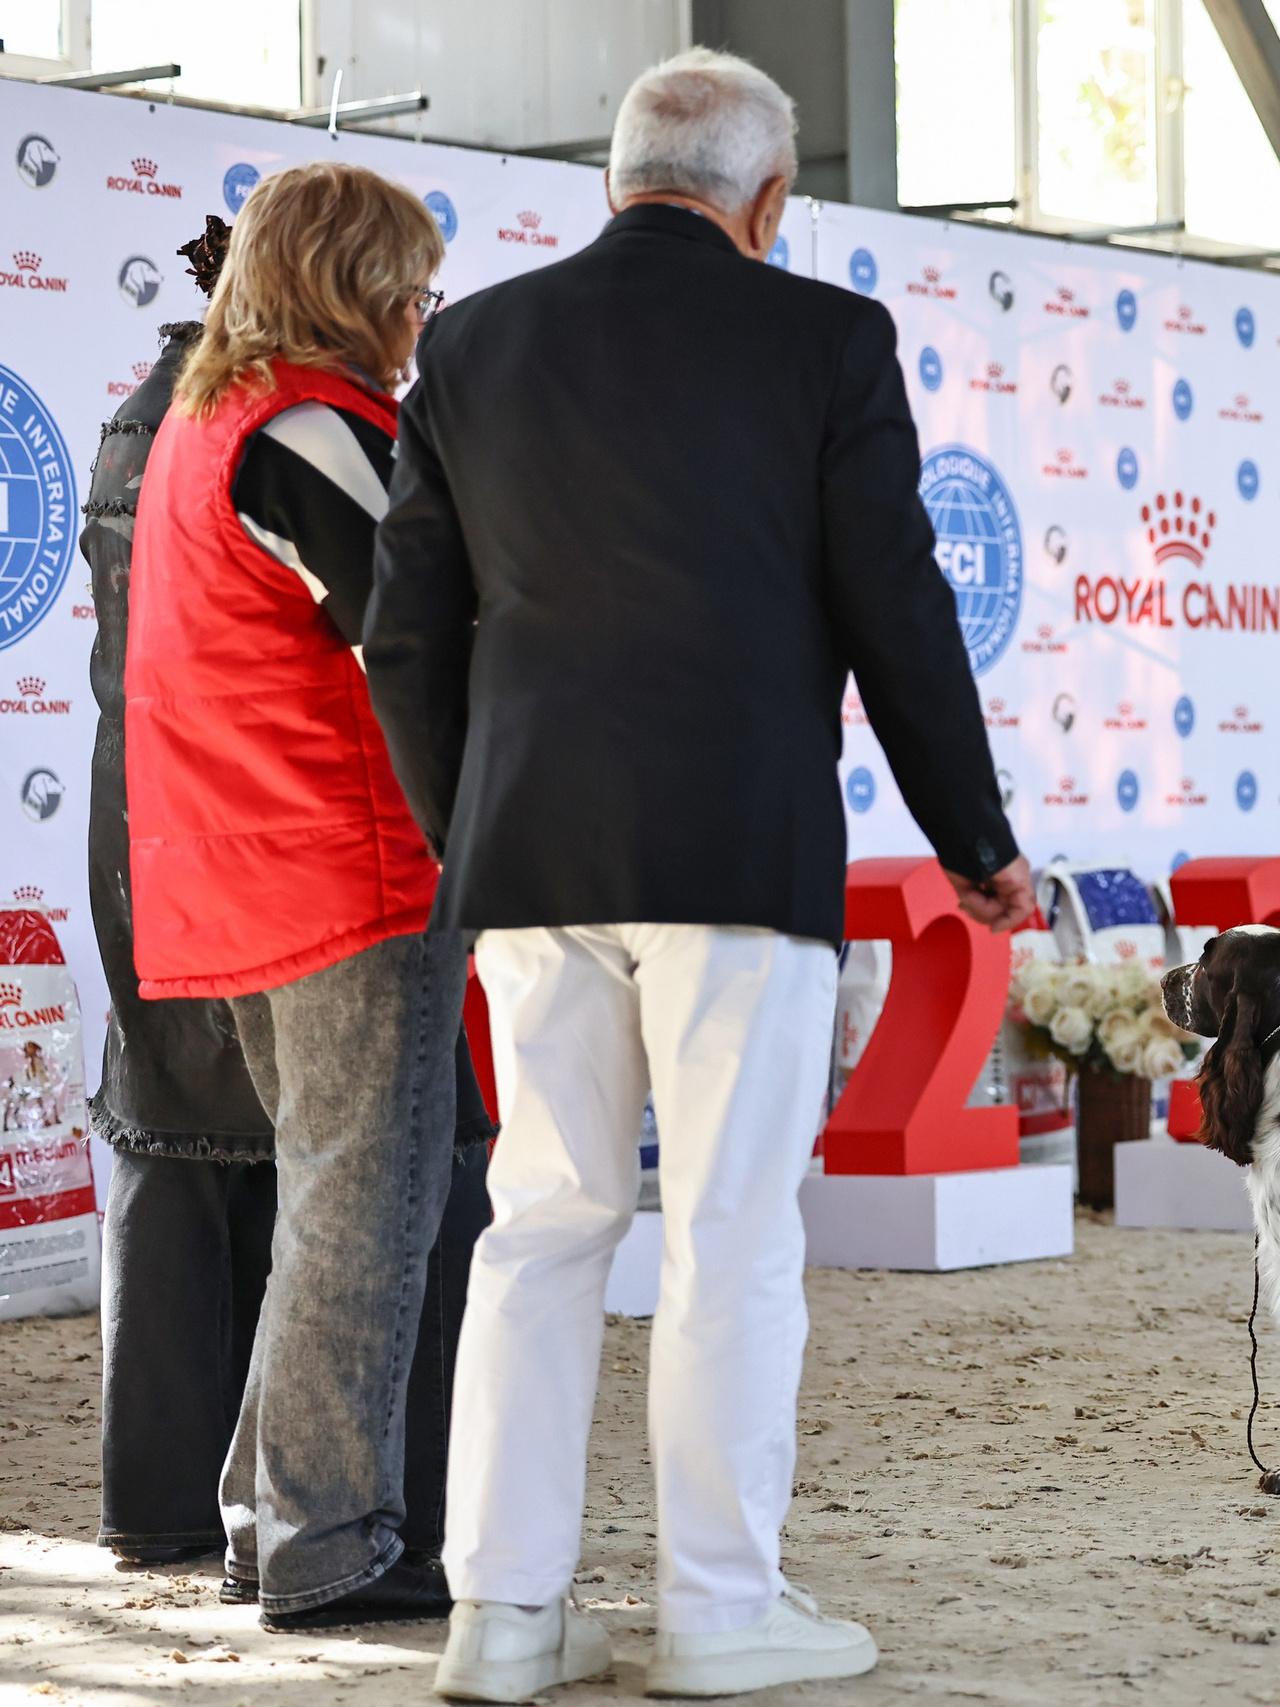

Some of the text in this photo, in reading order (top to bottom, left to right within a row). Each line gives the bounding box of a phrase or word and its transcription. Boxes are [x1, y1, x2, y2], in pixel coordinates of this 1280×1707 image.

[106, 175, 181, 199] ROYAL CANIN
[28, 275, 67, 292] CANIN
[933, 541, 986, 586] FCI
[1075, 574, 1280, 632] ROYAL CANIN
[32, 700, 70, 715] CANIN
[15, 1004, 65, 1027] CANIN
[823, 856, 1020, 1176] 2
